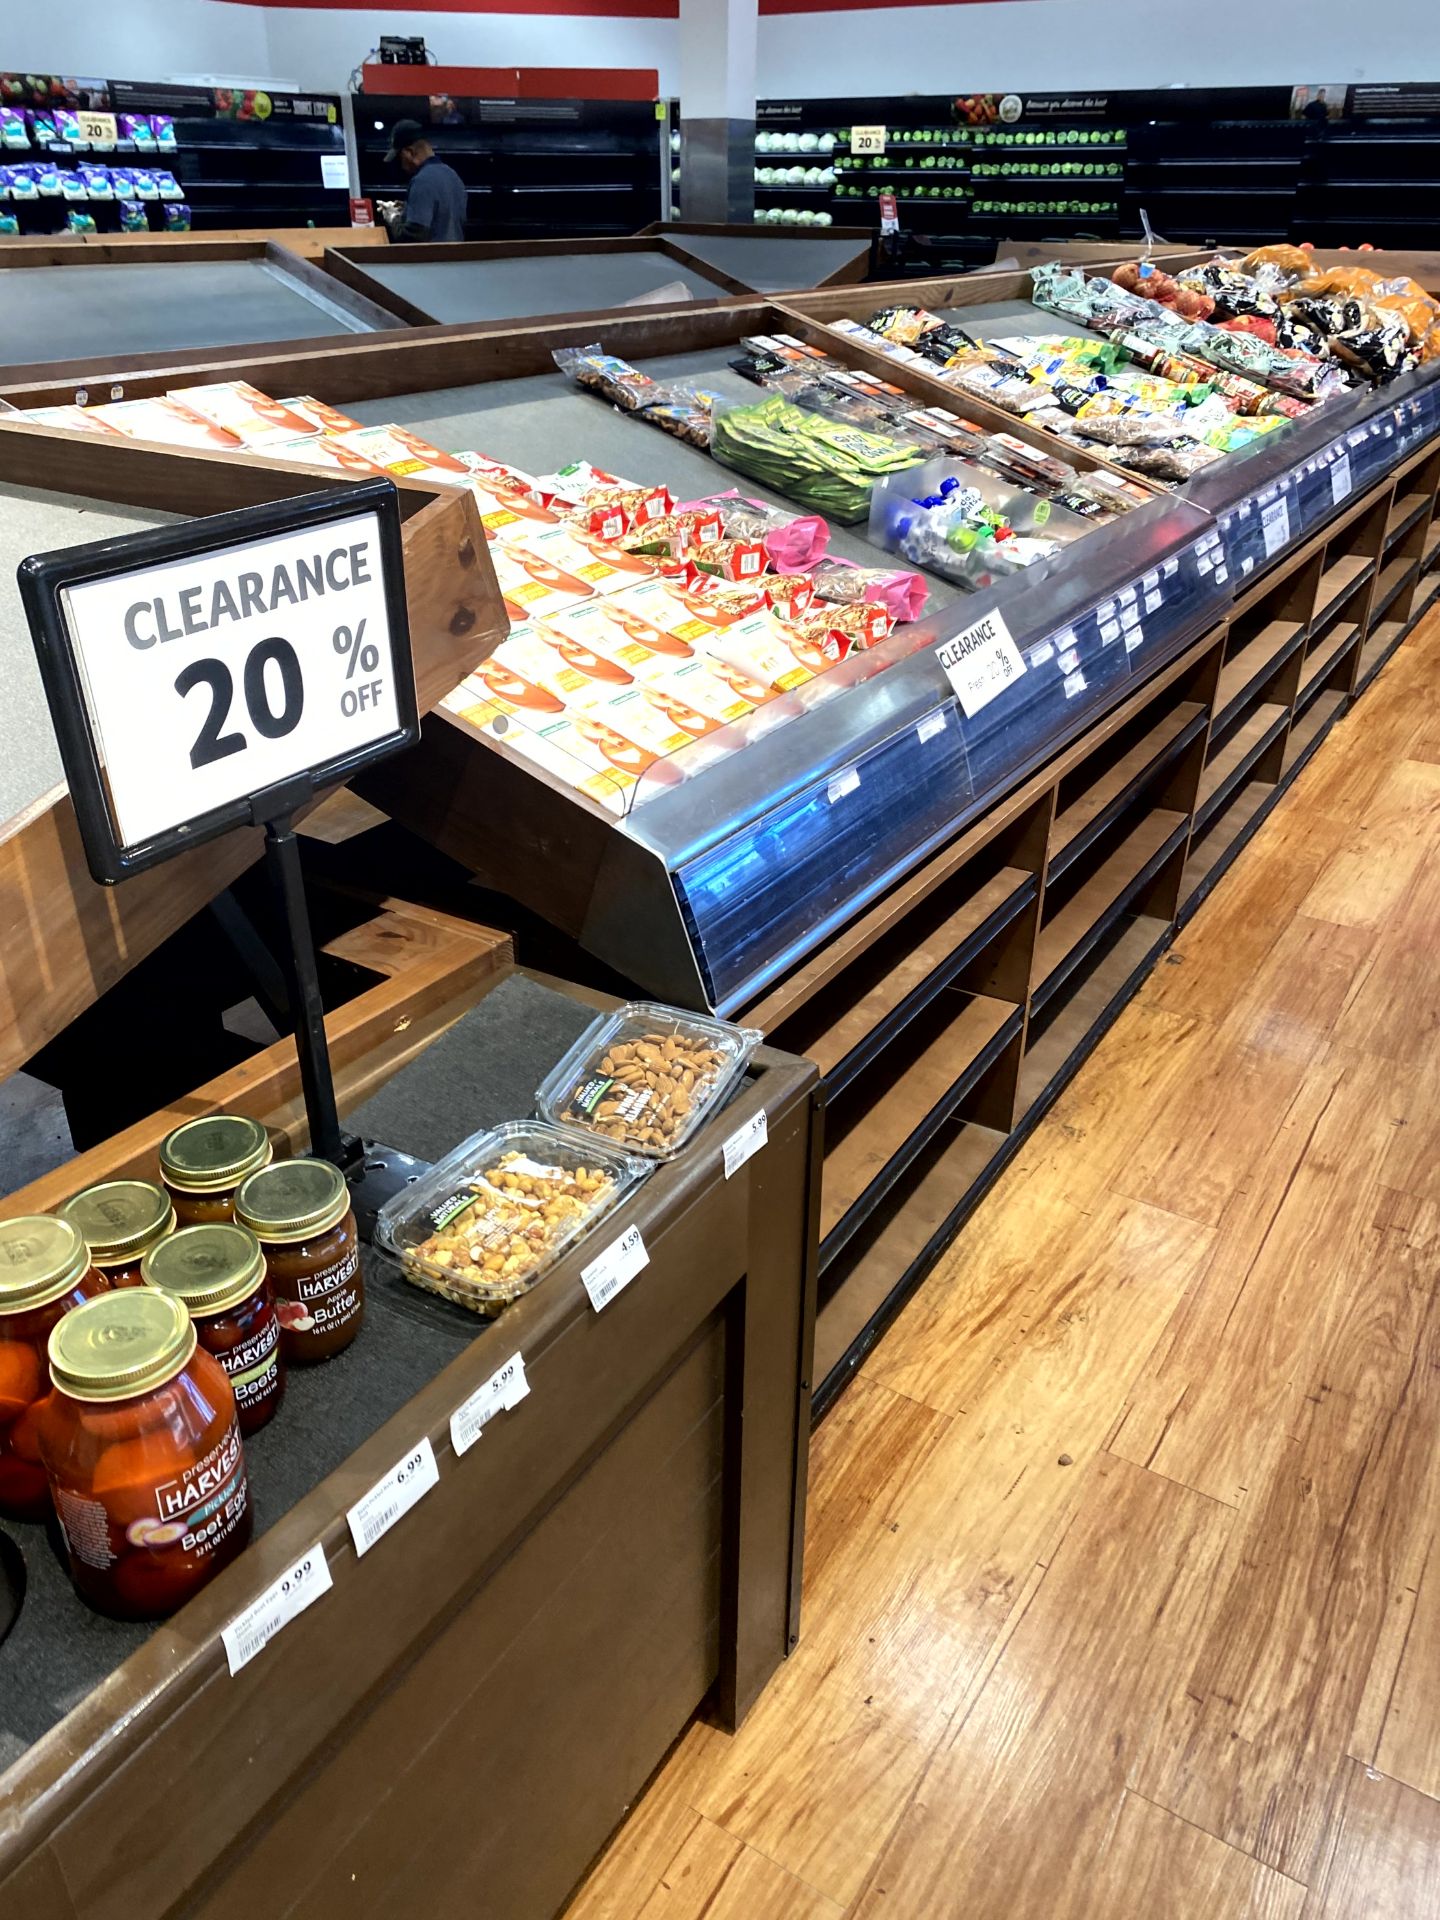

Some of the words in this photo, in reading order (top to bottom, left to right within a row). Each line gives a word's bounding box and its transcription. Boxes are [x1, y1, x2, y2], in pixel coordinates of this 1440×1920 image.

[86, 124, 102, 137] 20
[858, 137, 872, 149] 20
[124, 542, 373, 650] CLEARANCE
[939, 619, 997, 670] CLEARANCE
[996, 648, 1010, 667] %
[1003, 665, 1014, 678] OFF
[174, 636, 305, 770] 20
[332, 618, 380, 680] %
[340, 678, 384, 719] OFF
[576, 1081, 595, 1104] VALUED
[581, 1081, 606, 1108] NATURALS
[752, 1114, 767, 1133] 5.99
[429, 1195, 458, 1218] VALUED
[433, 1194, 470, 1225] NATURALS
[621, 1231, 640, 1252] 4.59
[303, 1255, 357, 1297] HARVEST
[313, 1252, 350, 1281] preserved
[313, 1289, 357, 1323] Butter
[326, 1288, 347, 1306] Apple
[221, 1326, 277, 1372] HARVEST
[232, 1321, 270, 1354] preserved
[234, 1363, 278, 1401] Beets
[492, 1365, 515, 1393] 5.99
[182, 1425, 233, 1484] preserved
[397, 1453, 422, 1484] 6.99
[165, 1430, 242, 1514] HARVEST
[182, 1513, 224, 1551] Beet
[225, 1479, 248, 1519] Eggs
[204, 1482, 237, 1517] Pickled
[281, 1560, 312, 1596] 9.99
